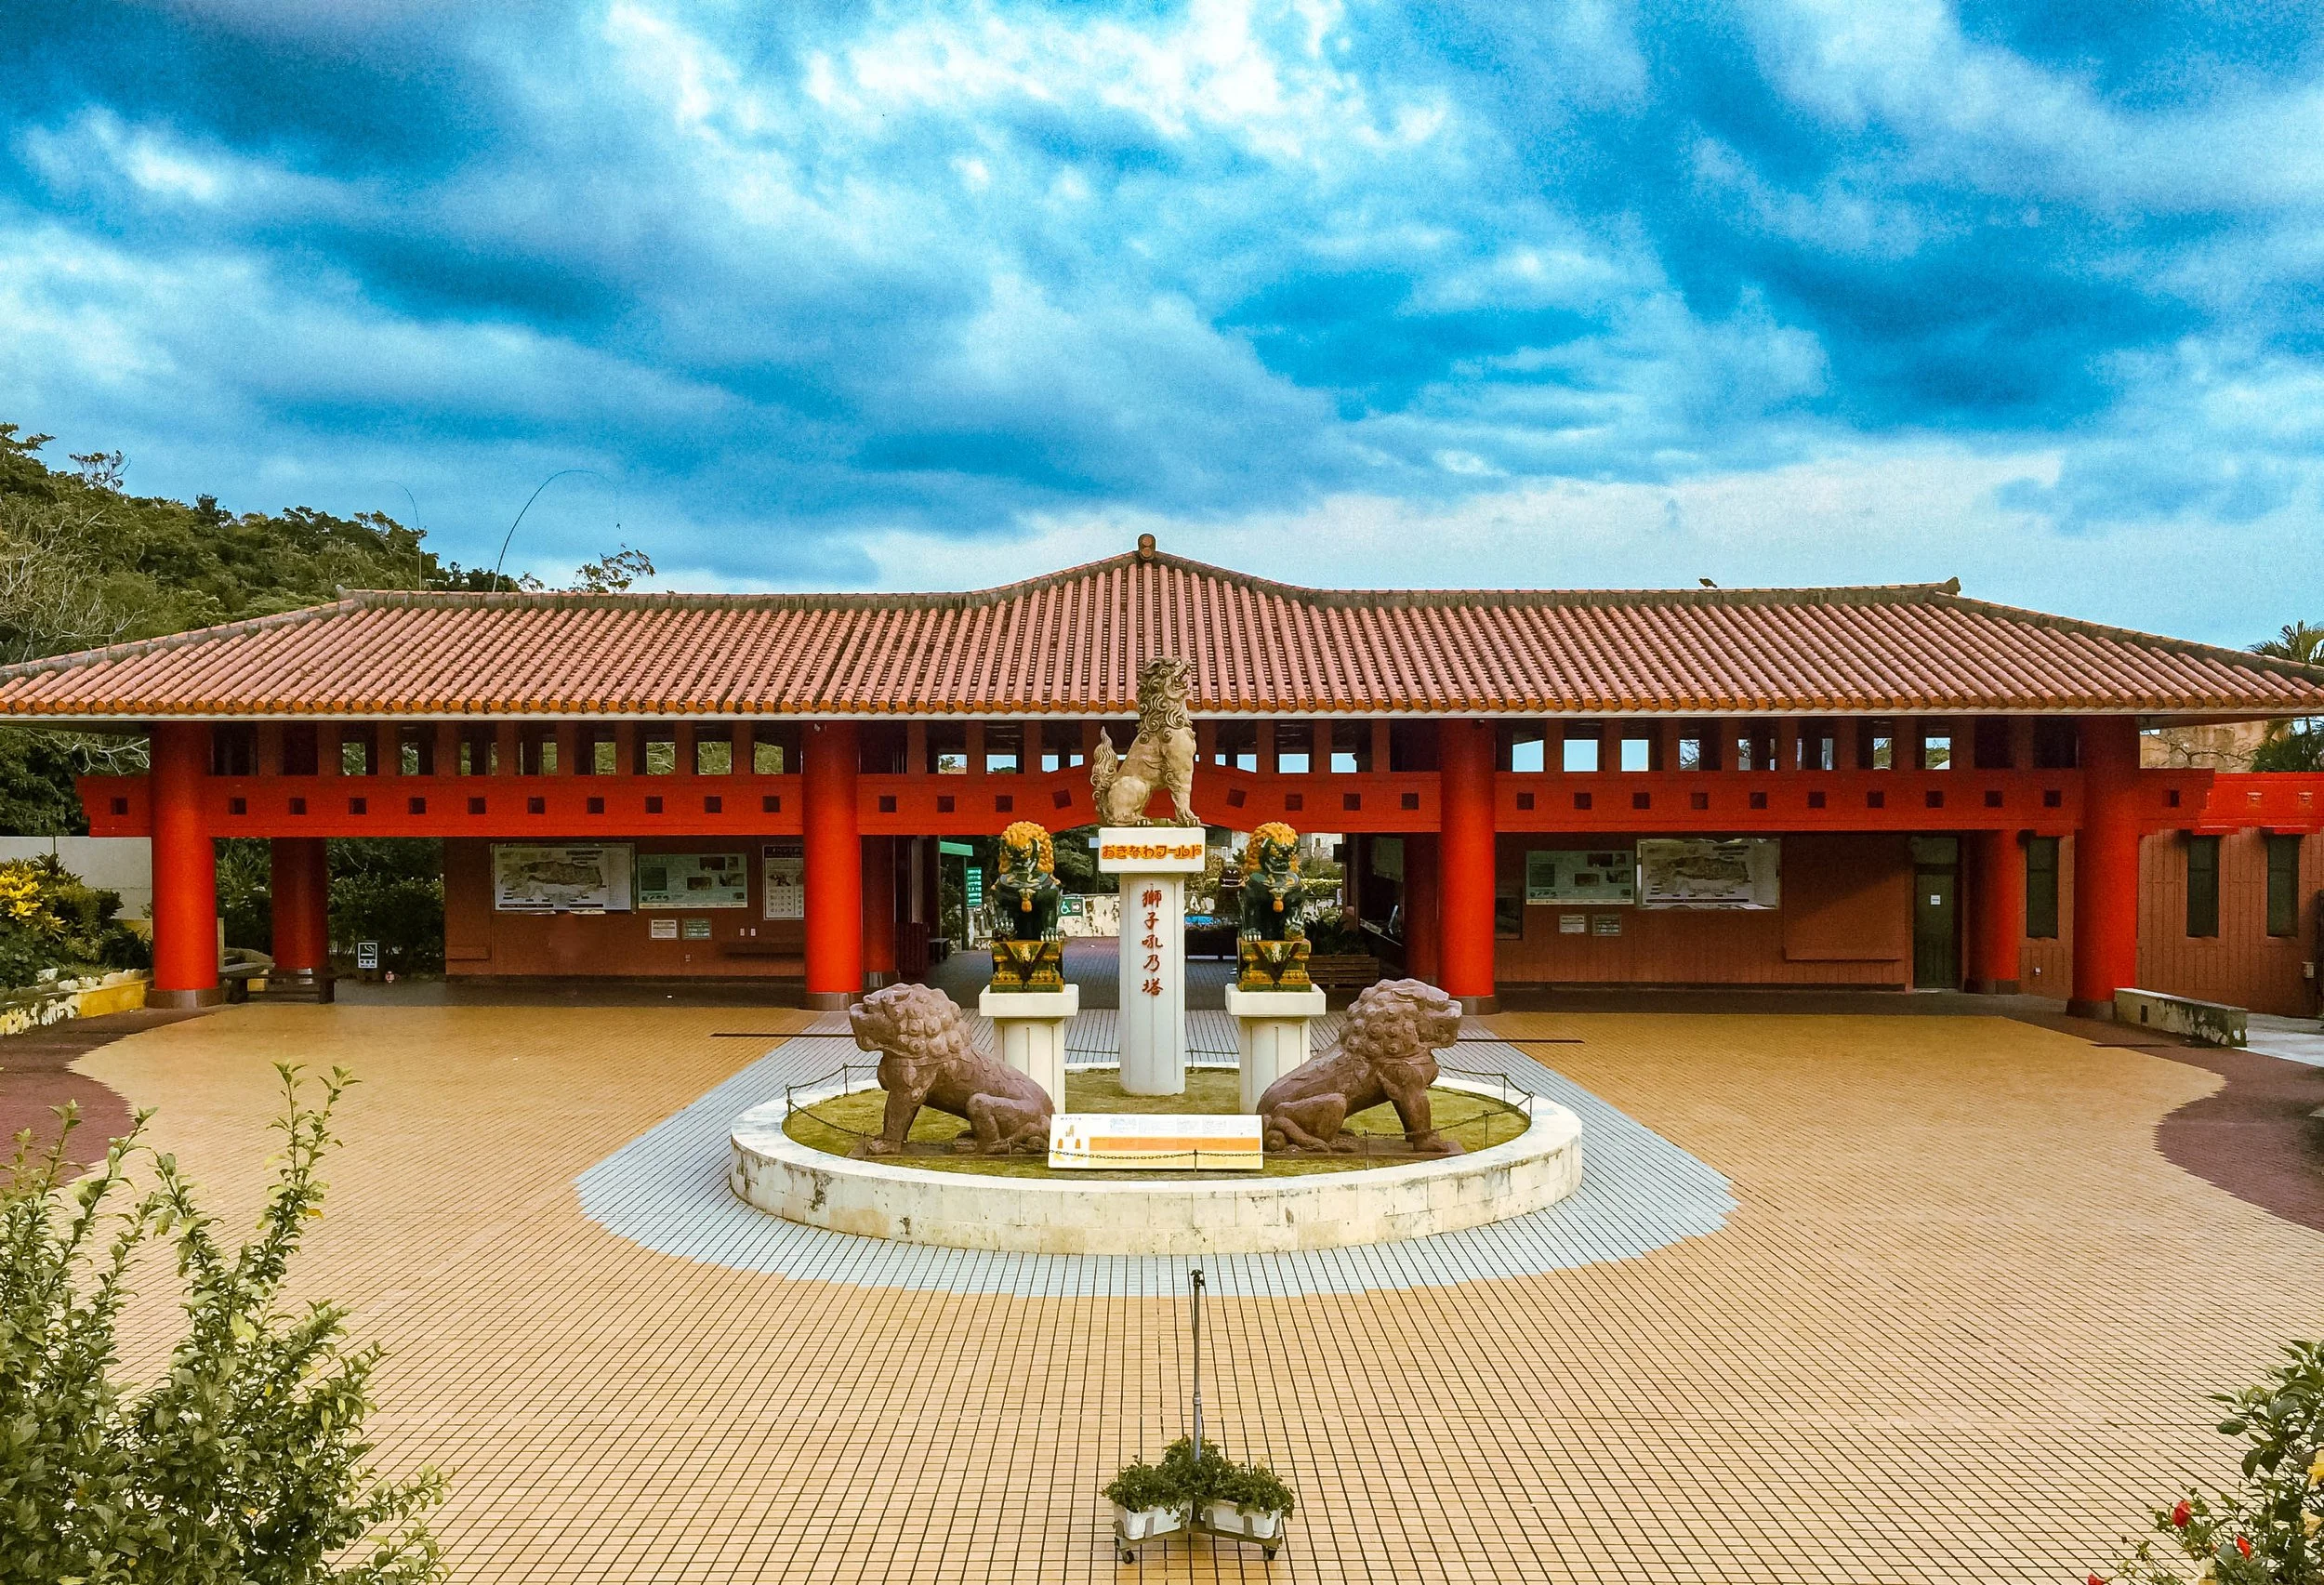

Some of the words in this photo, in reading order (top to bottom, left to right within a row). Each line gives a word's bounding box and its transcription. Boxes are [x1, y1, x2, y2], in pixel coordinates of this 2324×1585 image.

[1102, 845, 1203, 859] おきなわワールド
